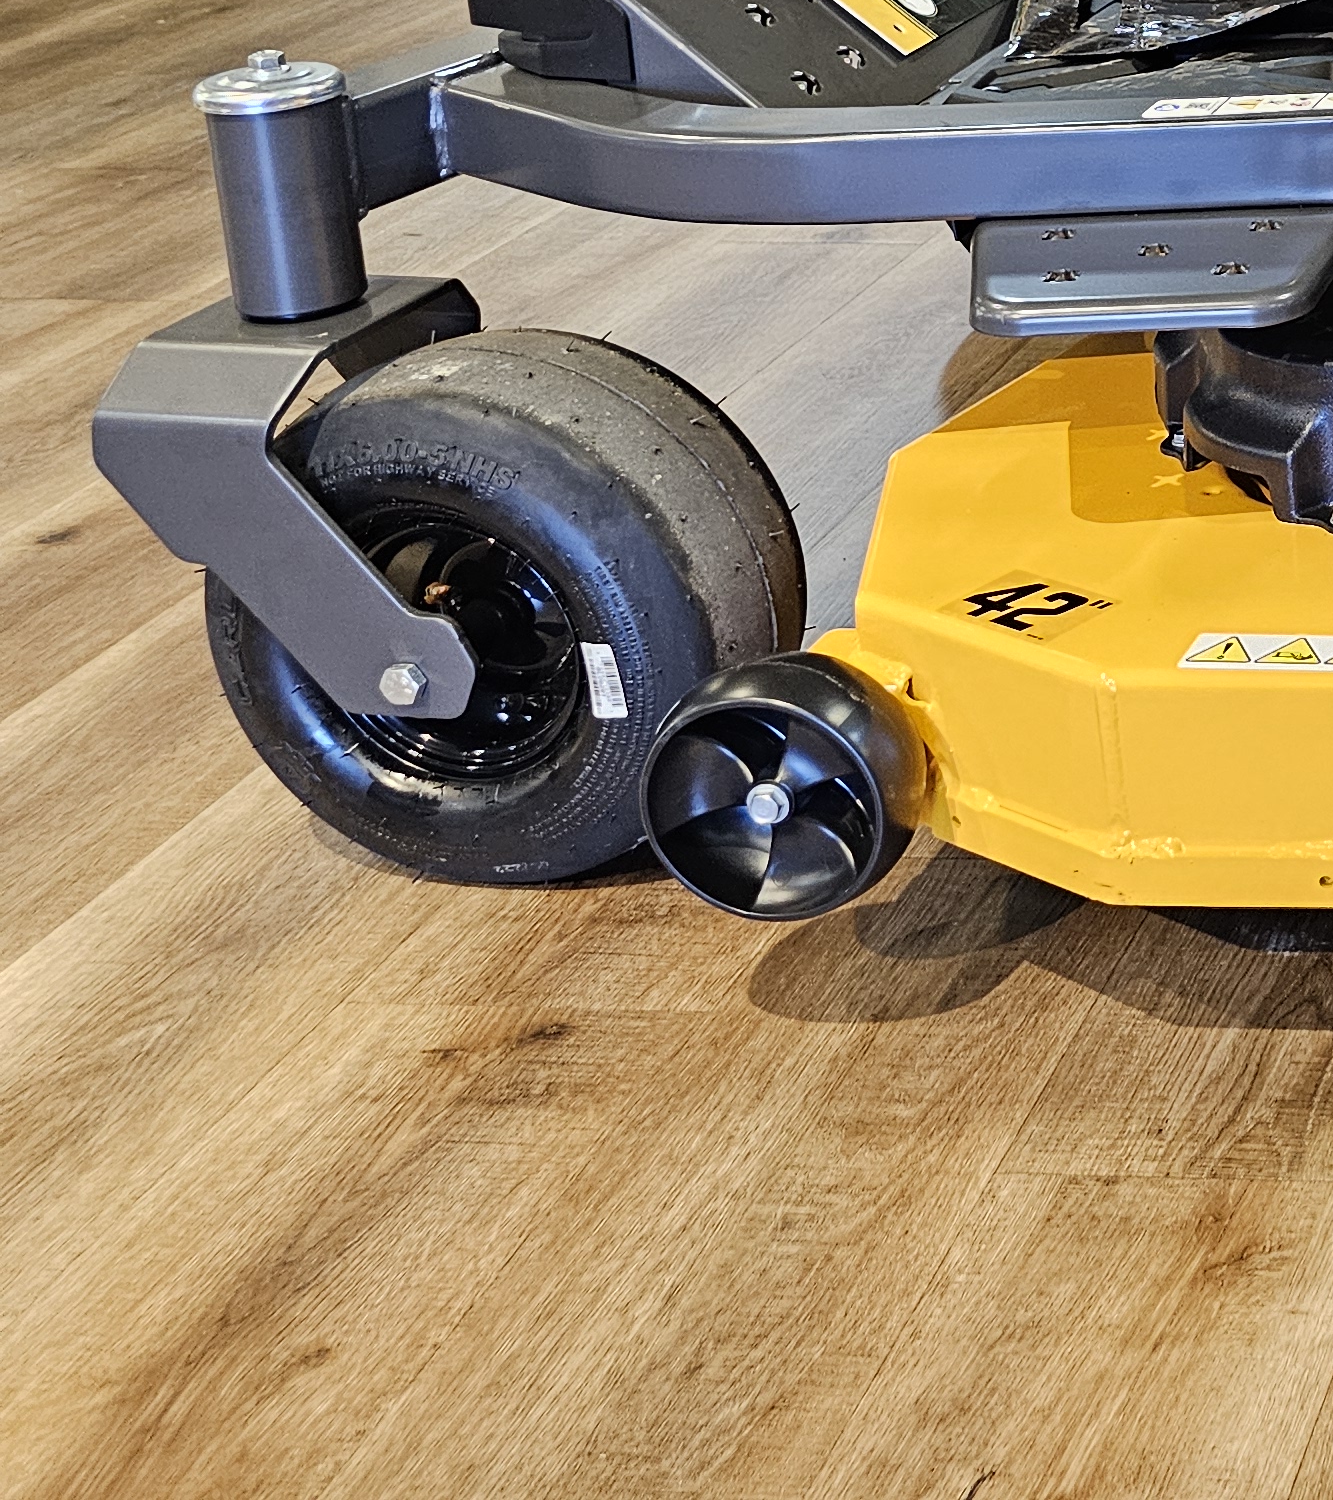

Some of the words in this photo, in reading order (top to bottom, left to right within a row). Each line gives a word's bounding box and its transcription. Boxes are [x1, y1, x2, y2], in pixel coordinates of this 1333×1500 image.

[320, 472, 344, 488] NOT
[348, 465, 372, 478] FOR
[373, 463, 437, 477] HIGHWAY
[962, 583, 1114, 631] 42"
